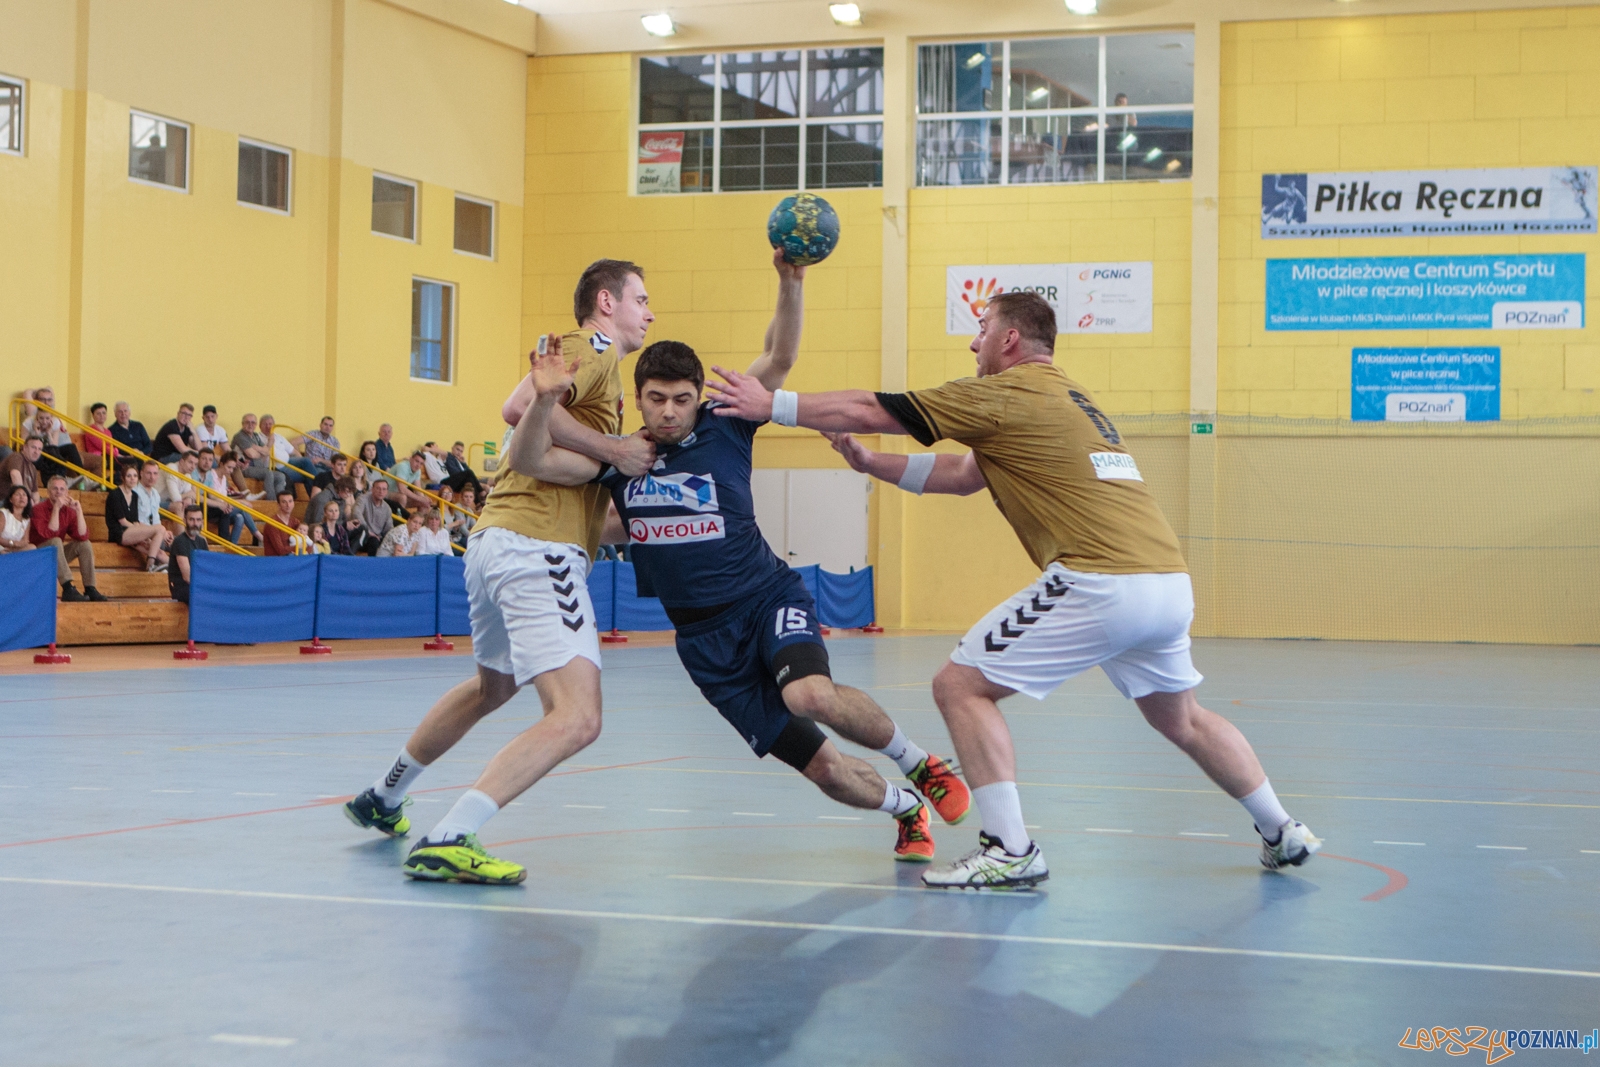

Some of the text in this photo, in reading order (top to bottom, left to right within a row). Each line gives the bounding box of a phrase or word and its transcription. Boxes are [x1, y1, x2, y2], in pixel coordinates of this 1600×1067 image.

[1314, 181, 1543, 218] Piłka Ręczna
[1412, 223, 1505, 233] Handball
[1093, 269, 1131, 279] PGNiG
[1292, 261, 1555, 281] Młodzieżowe Centrum Sportu
[1317, 286, 1331, 297] w
[1334, 283, 1368, 300] piłce
[1371, 282, 1424, 300] ręcznej
[1434, 281, 1527, 299] koszykówce
[1095, 318, 1116, 326] ZPRP
[1420, 353, 1461, 364] Centrum
[1462, 353, 1495, 365] Sportu
[651, 520, 719, 538] VEOLIA
[775, 607, 807, 636] 15
